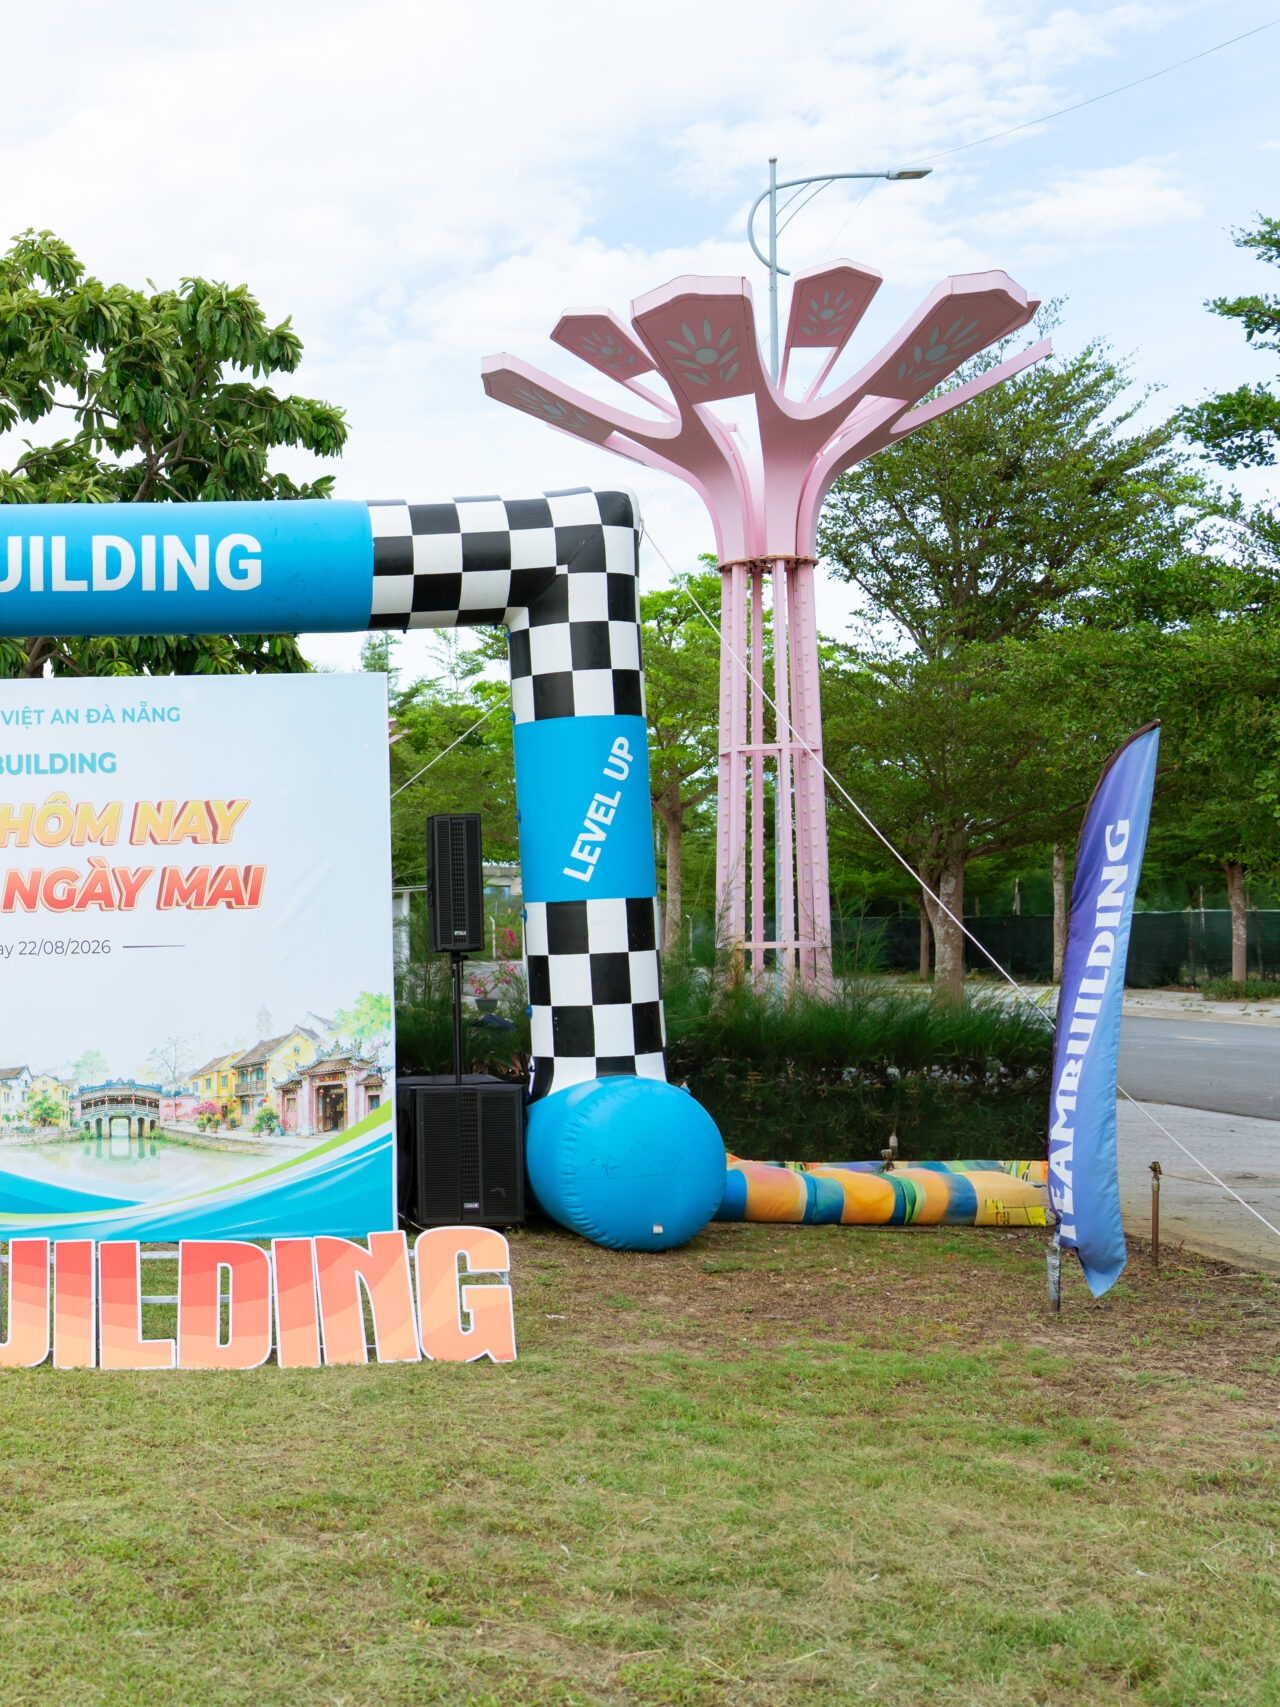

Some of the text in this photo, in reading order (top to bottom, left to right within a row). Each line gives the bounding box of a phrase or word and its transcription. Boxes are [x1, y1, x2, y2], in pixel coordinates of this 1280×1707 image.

[0, 706, 45, 729] VIỆT
[50, 708, 80, 724] AN
[85, 704, 116, 724] ĐÀ
[121, 701, 181, 723] NẴNG
[129, 799, 252, 846] NAY
[562, 736, 634, 883] LEVEL UP
[0, 856, 156, 913] NGÀY
[156, 863, 267, 910] MAI
[18, 938, 112, 957] 22/08/2026
